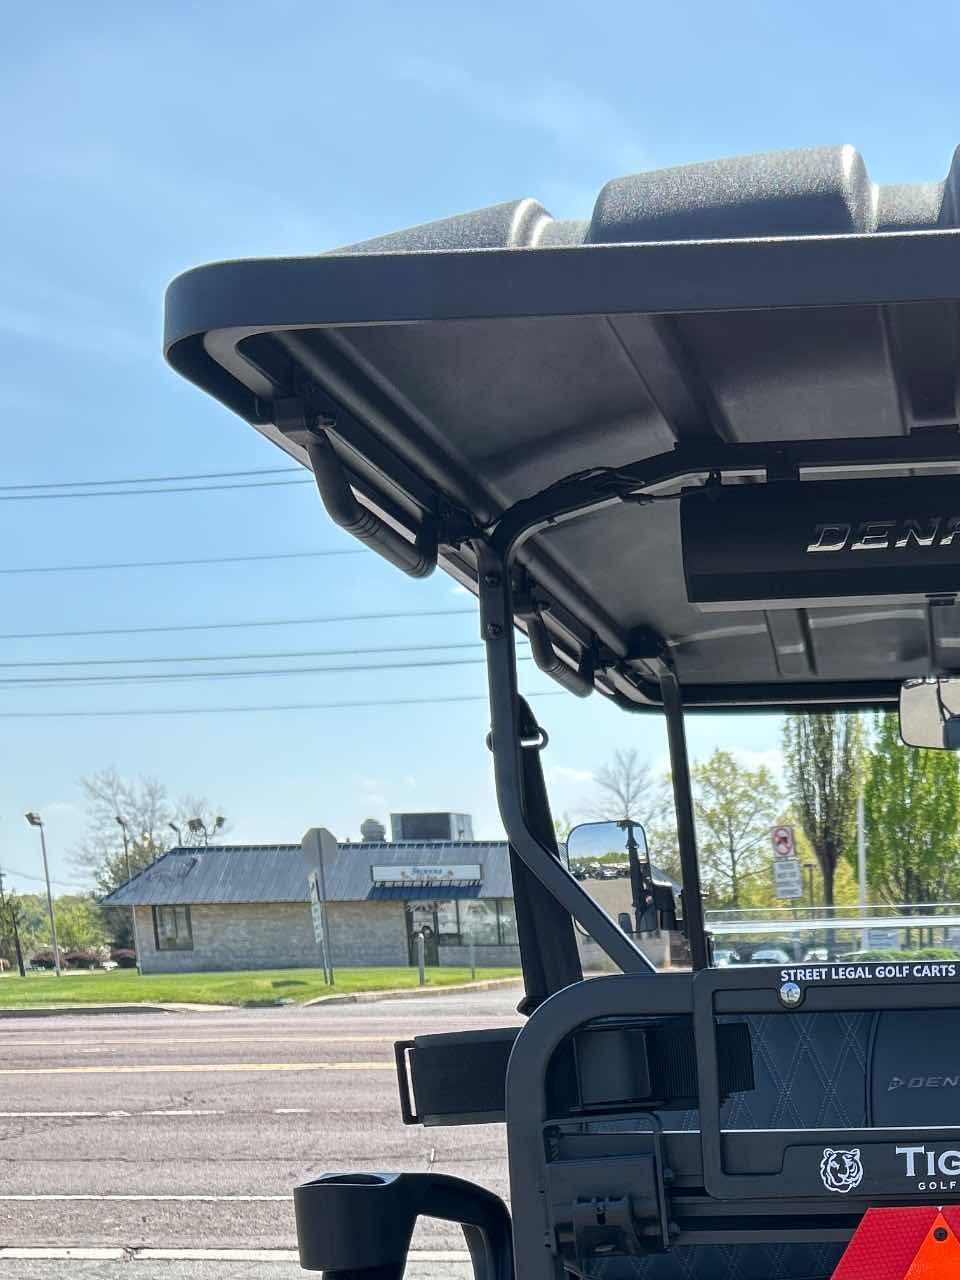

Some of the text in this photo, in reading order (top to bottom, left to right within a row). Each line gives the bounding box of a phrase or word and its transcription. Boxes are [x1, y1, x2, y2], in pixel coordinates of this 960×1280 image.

[780, 968, 828, 982] STREET
[831, 966, 872, 980] LEGAL
[875, 966, 909, 979] GOLF
[912, 964, 956, 978] CARTS
[918, 1181, 957, 1190] GOLF
